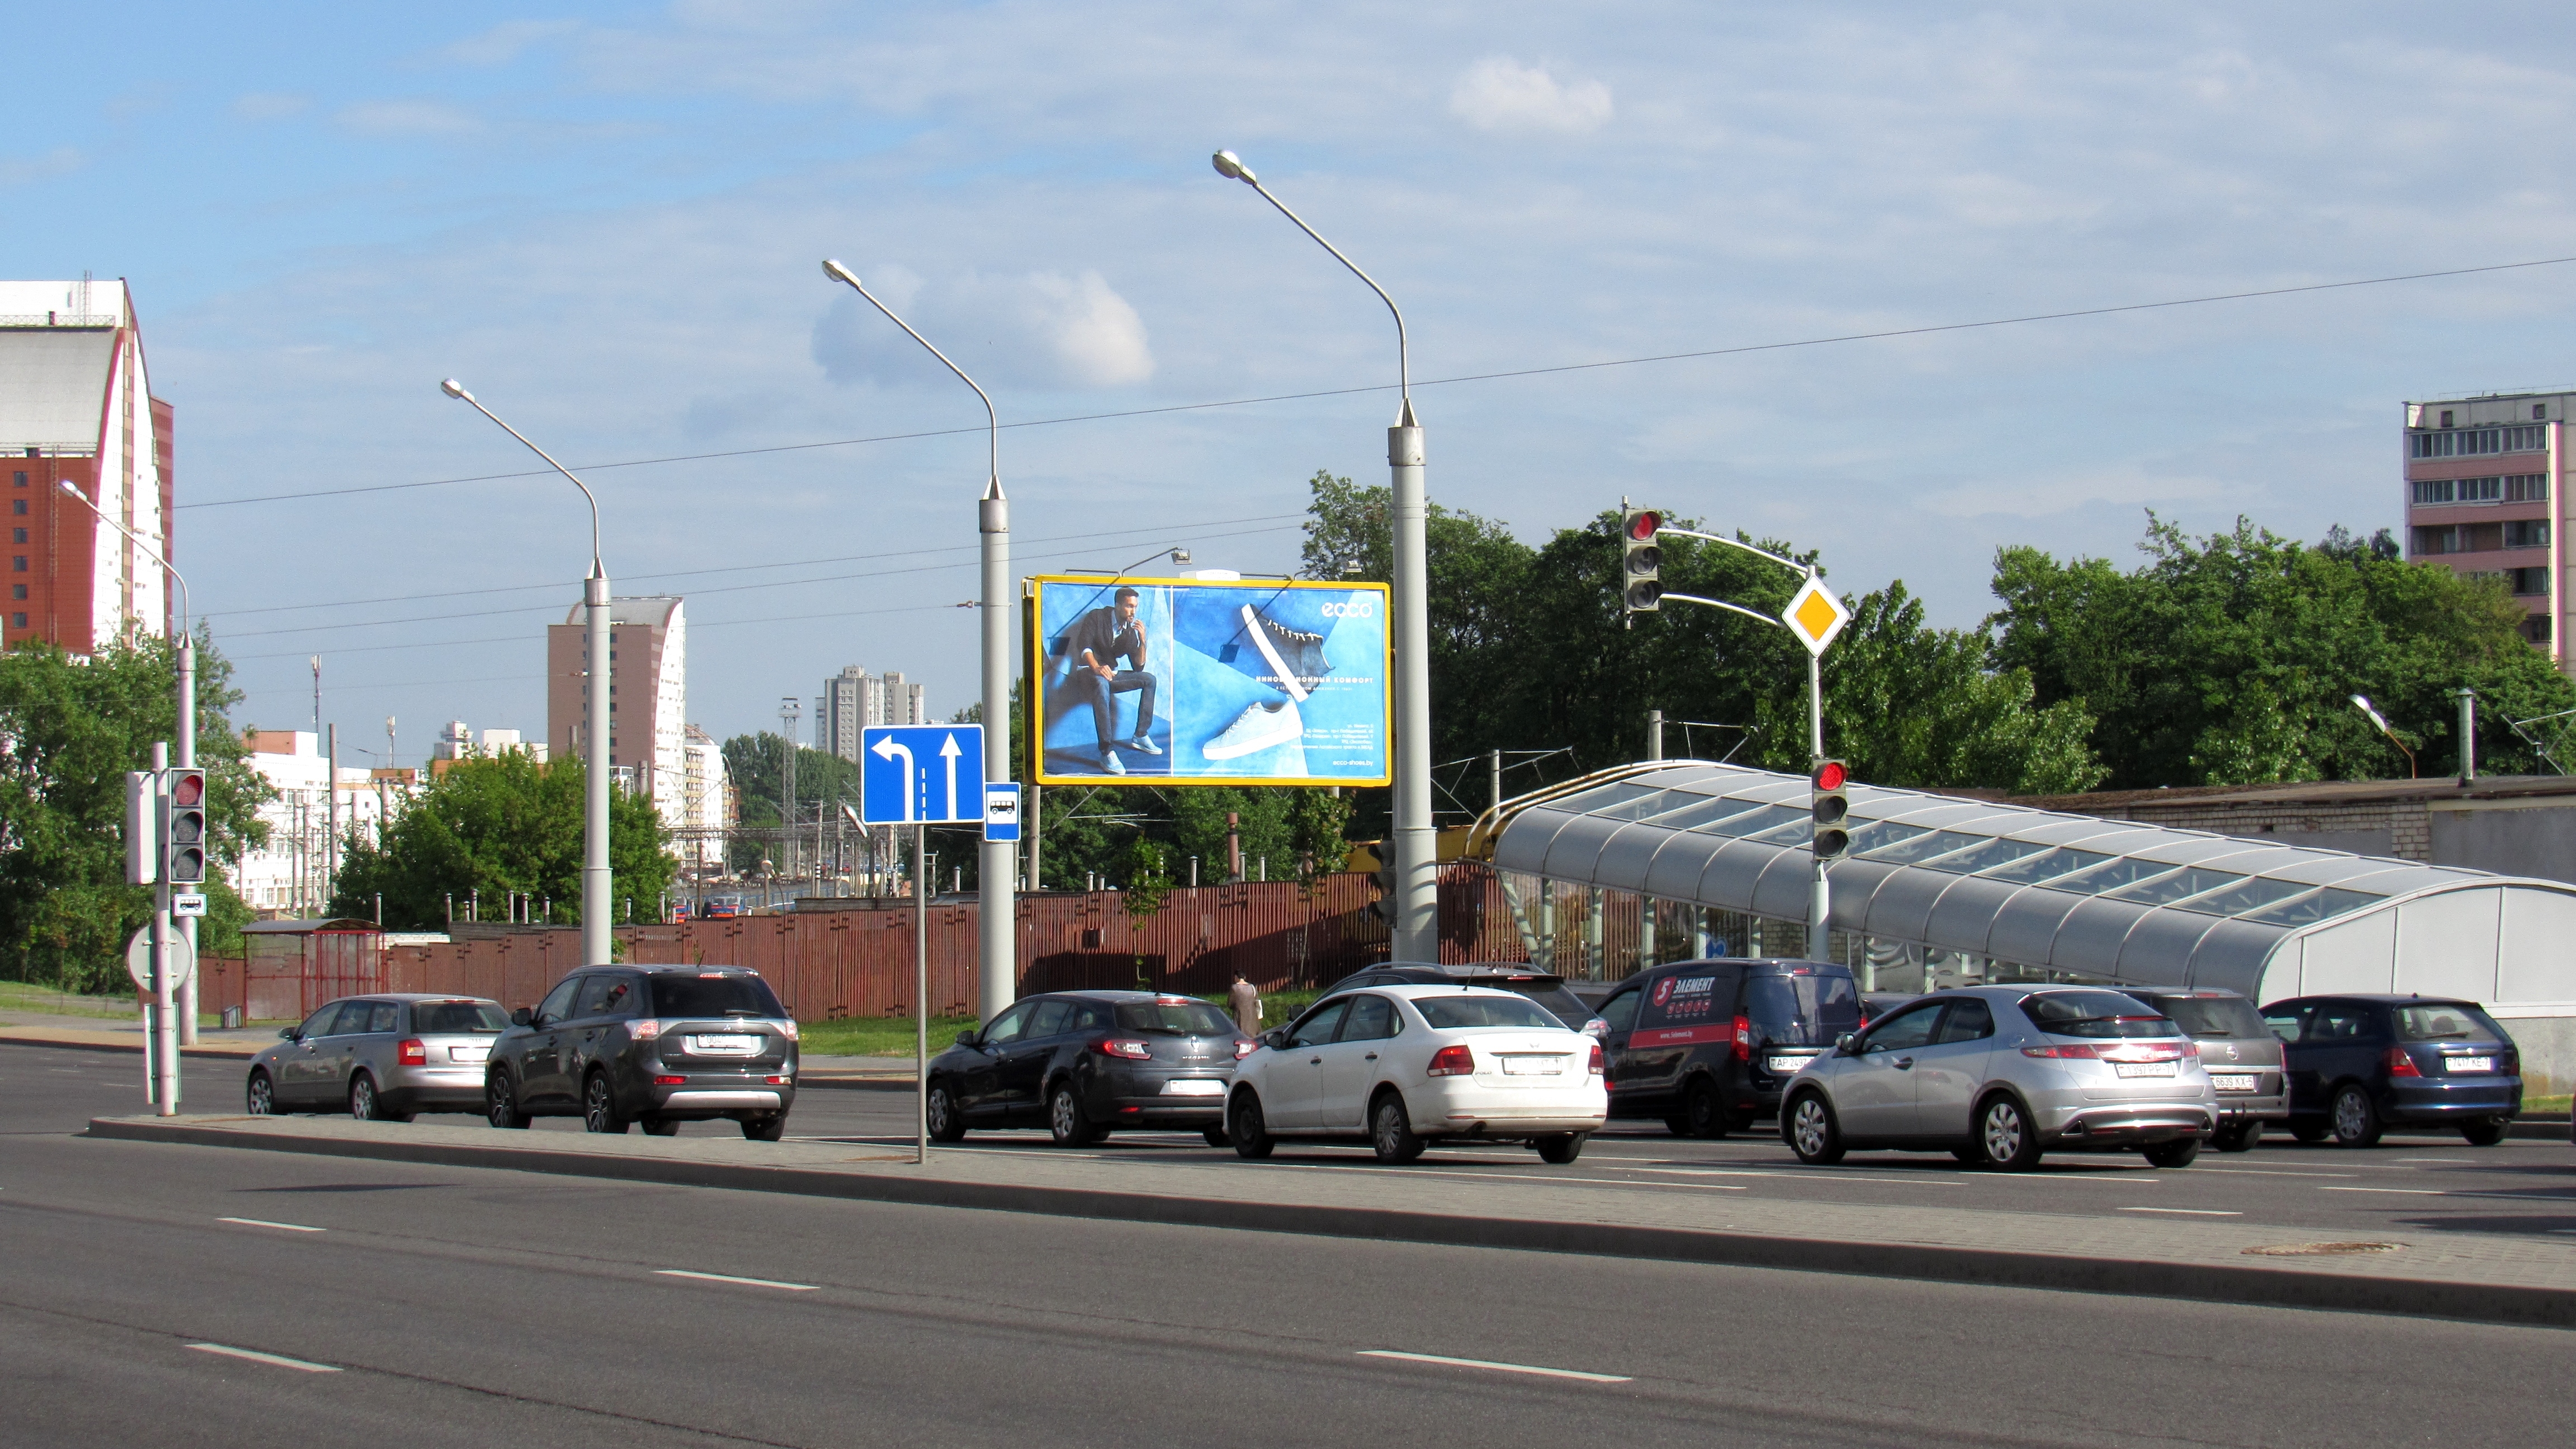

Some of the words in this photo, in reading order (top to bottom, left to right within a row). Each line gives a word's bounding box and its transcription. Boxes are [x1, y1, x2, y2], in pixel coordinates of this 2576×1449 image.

[1321, 602, 1373, 618] ecco
[1657, 981, 1671, 1000] 5
[1673, 977, 1716, 994] ЭЛЕМЕНТ
